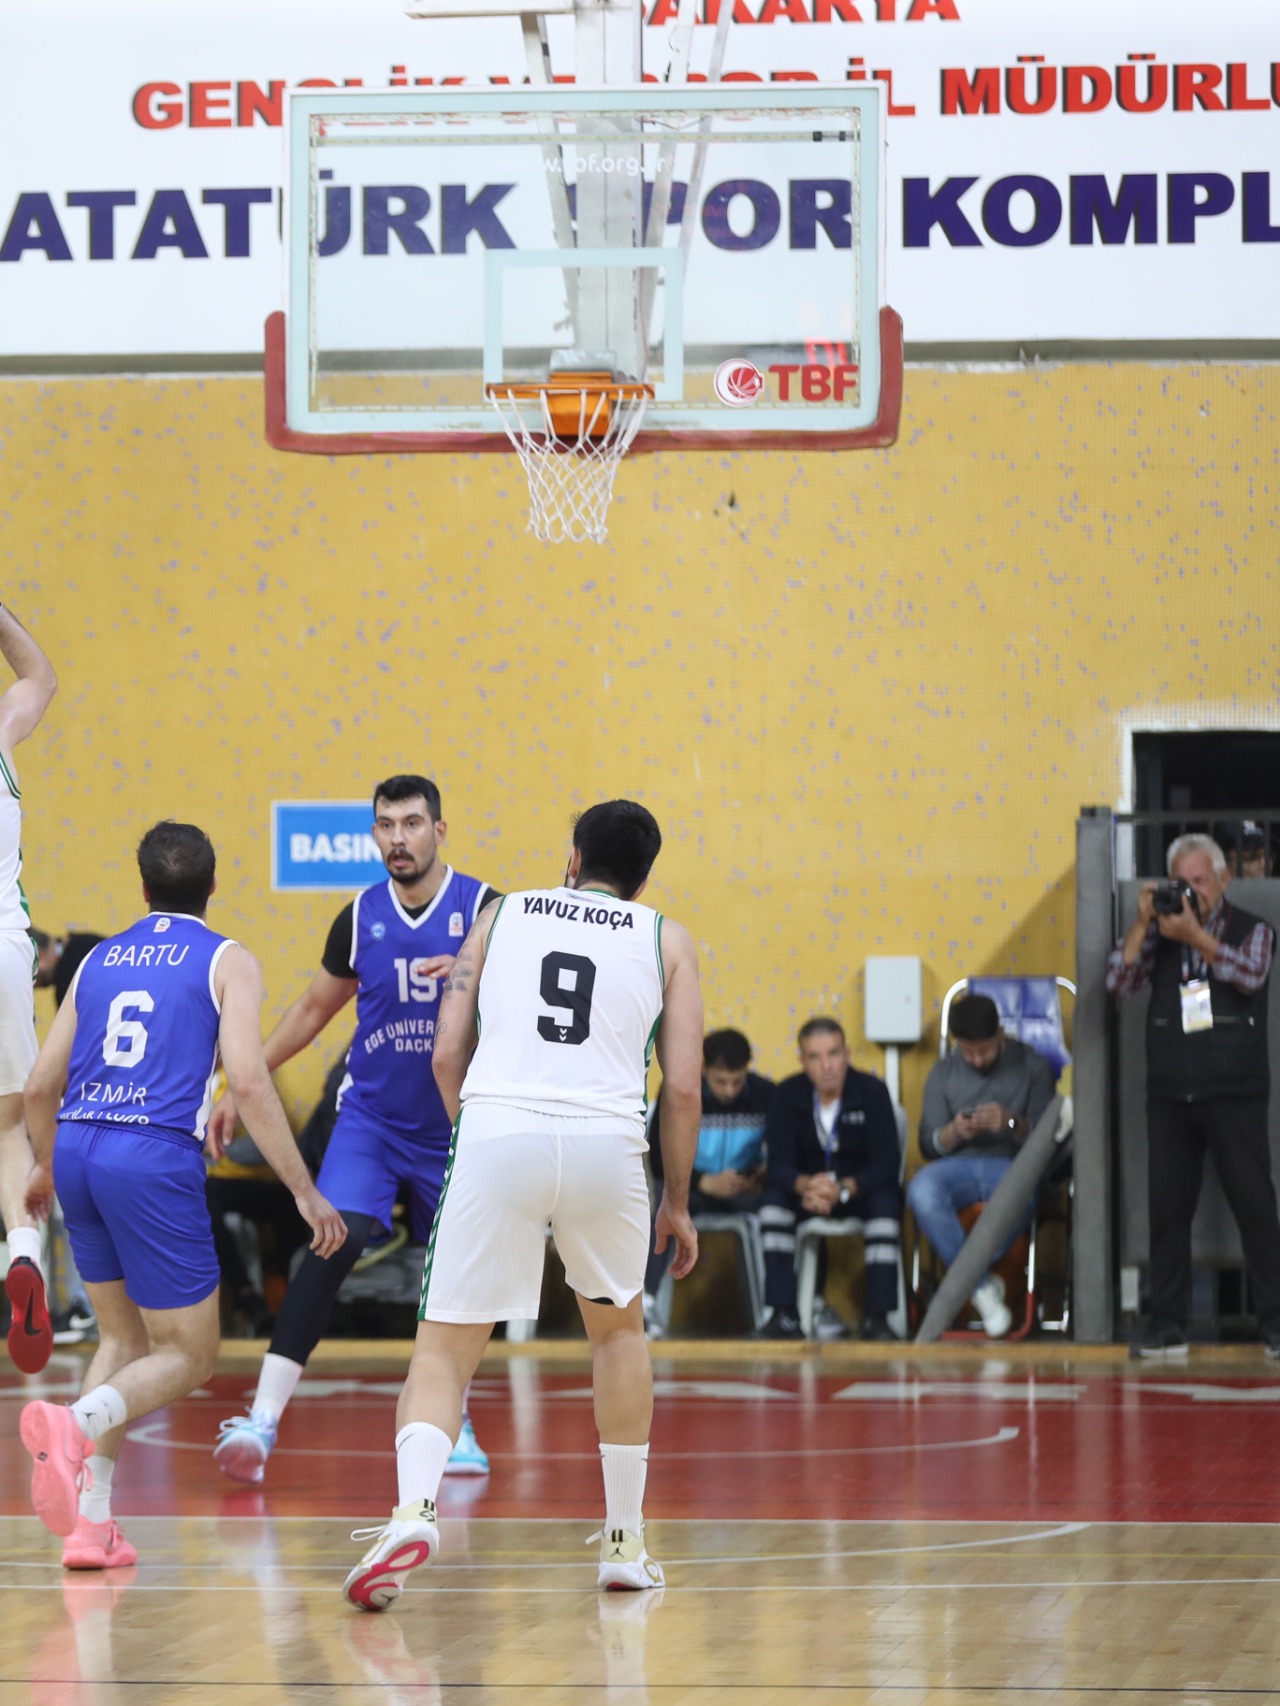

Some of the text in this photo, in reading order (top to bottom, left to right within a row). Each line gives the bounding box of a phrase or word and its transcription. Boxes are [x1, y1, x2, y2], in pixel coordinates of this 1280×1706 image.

[643, 0, 961, 26] AKARYA
[940, 53, 1280, 115] MÜDÜRL
[565, 176, 852, 252] POR
[902, 171, 1280, 248] KOMPL
[768, 364, 859, 402] TBF
[523, 897, 580, 921] YAVUZ
[583, 907, 634, 930] KOÇA
[103, 944, 189, 966] BARTU
[537, 951, 596, 1045] 9
[103, 990, 154, 1068] 6
